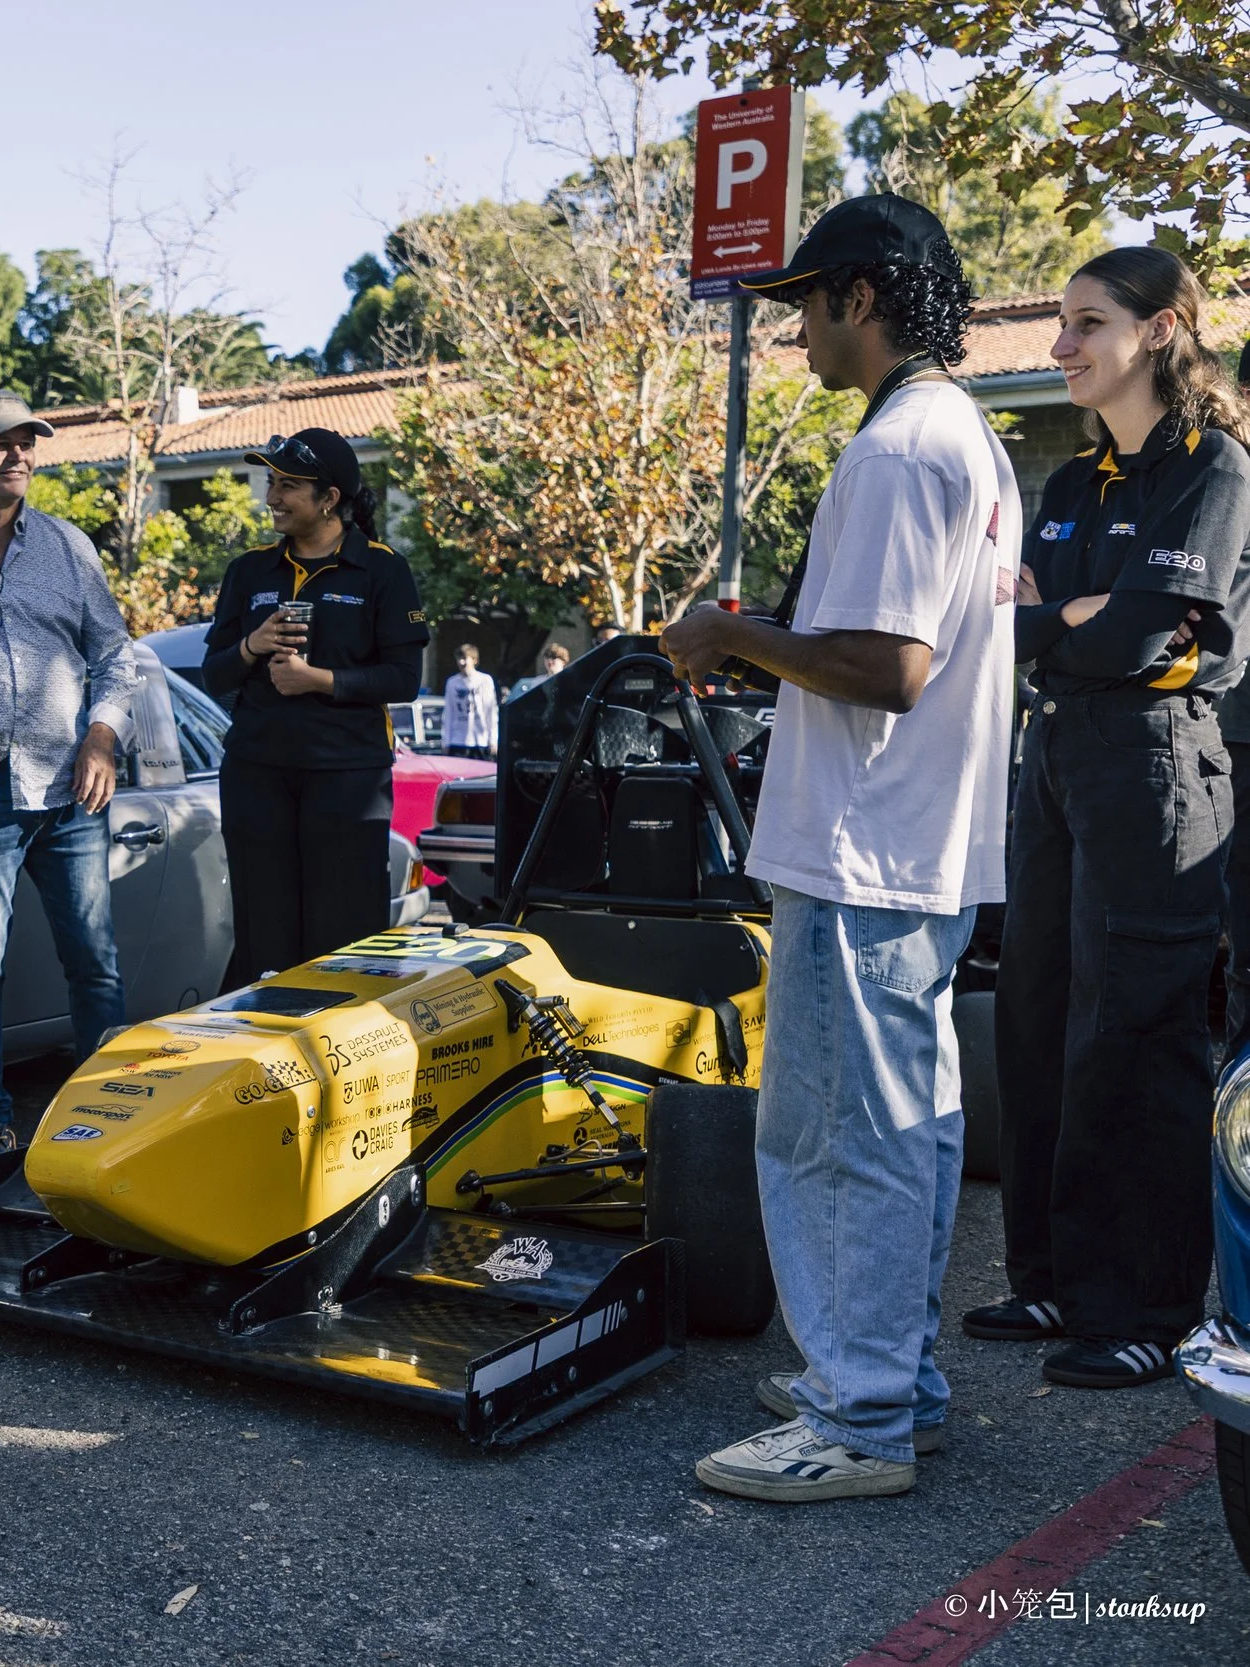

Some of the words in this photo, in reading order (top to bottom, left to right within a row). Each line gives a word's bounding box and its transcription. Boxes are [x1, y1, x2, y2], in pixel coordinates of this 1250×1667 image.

[711, 120, 742, 131] Western
[743, 114, 775, 125] Australia
[714, 113, 728, 122] The
[729, 107, 764, 120] University
[716, 139, 768, 210] P
[707, 223, 736, 233] Monday
[746, 218, 769, 227] Friday
[1148, 549, 1206, 571] E20
[330, 934, 507, 963] E20
[432, 998, 455, 1012] Mining
[458, 987, 486, 1002] Hydraulic
[451, 1003, 476, 1017] Supplies
[347, 1022, 401, 1050] DASSAULT
[431, 1040, 470, 1060] BROOKS
[472, 1035, 494, 1049] HIRE
[583, 1034, 608, 1048] DELL
[608, 1023, 660, 1043] Technologies
[147, 1052, 190, 1061] TOYOTA
[354, 1075, 380, 1096] UWA
[386, 1070, 411, 1088] SPORT
[416, 1057, 481, 1088] PRIMERO
[63, 1127, 99, 1138] SAE
[298, 1123, 321, 1137] edge
[324, 1112, 360, 1130] workshop
[369, 1121, 398, 1138] DAVIES
[369, 1136, 394, 1155] CRAIG
[513, 1236, 548, 1260] WA
